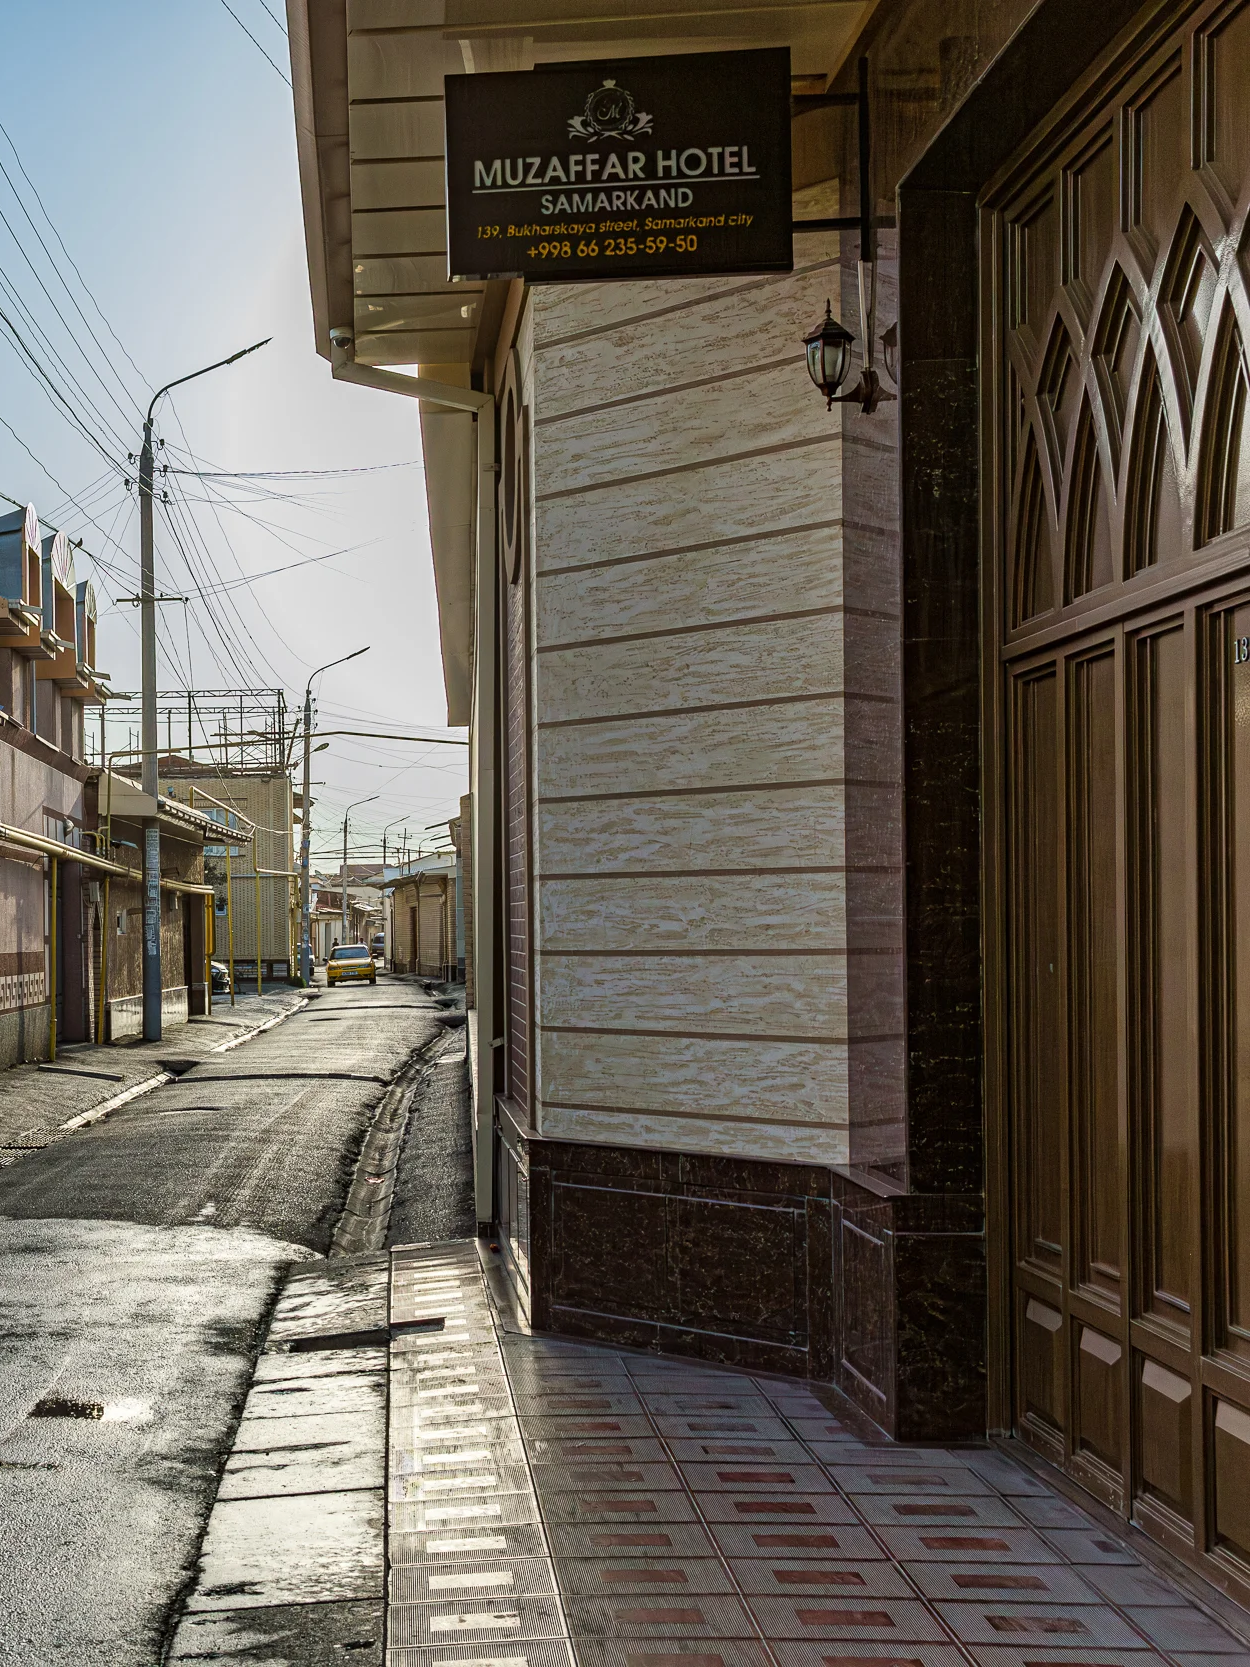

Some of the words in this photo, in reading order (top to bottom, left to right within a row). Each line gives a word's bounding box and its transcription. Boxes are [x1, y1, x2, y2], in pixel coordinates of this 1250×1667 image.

[474, 151, 646, 187] MUZAFFAR
[657, 146, 757, 177] HOTEL
[541, 187, 693, 215] SAMARKAND
[477, 225, 502, 239] 139,
[507, 222, 596, 237] Bukharskaya
[644, 213, 726, 230] Samarkand
[728, 212, 754, 228] city
[526, 241, 571, 259] +998
[576, 239, 599, 257] 66
[603, 234, 698, 256] 235-59-50
